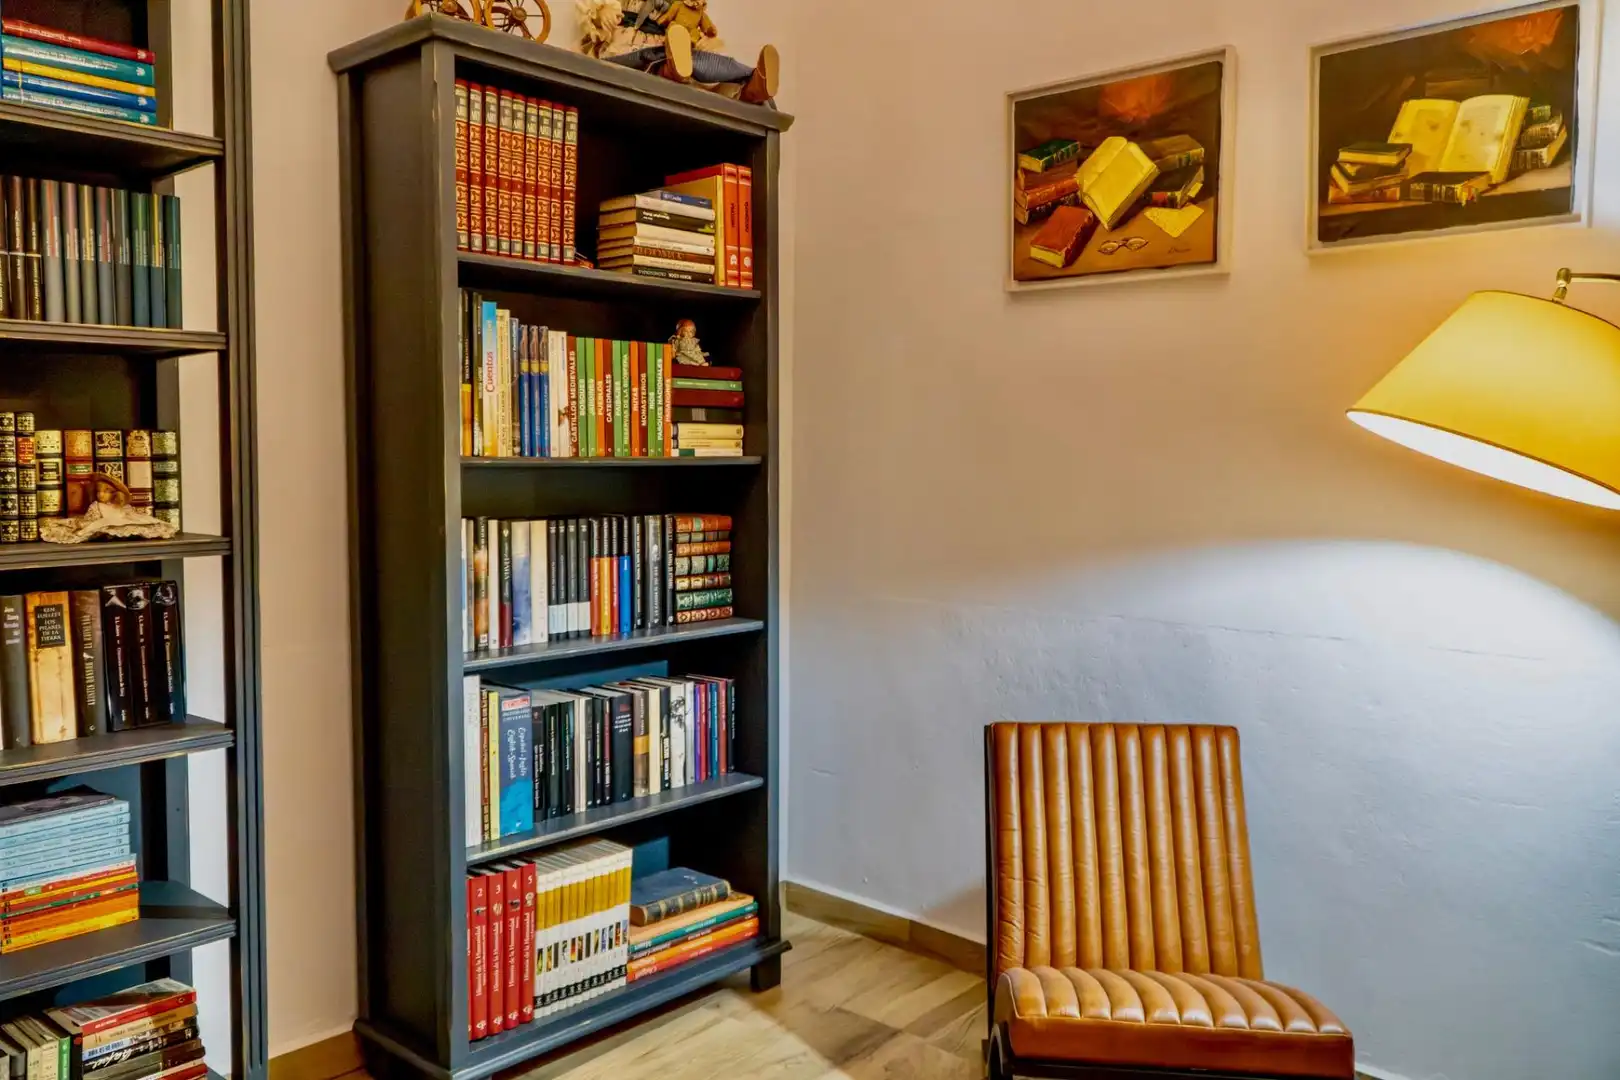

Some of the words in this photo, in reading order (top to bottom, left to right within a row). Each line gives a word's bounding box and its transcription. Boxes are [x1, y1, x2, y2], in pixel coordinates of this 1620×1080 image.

[485, 351, 495, 392] Cuentos
[528, 876, 532, 884] 5
[496, 885, 500, 894] 3
[512, 881, 517, 889] 4
[477, 888, 483, 897] 2
